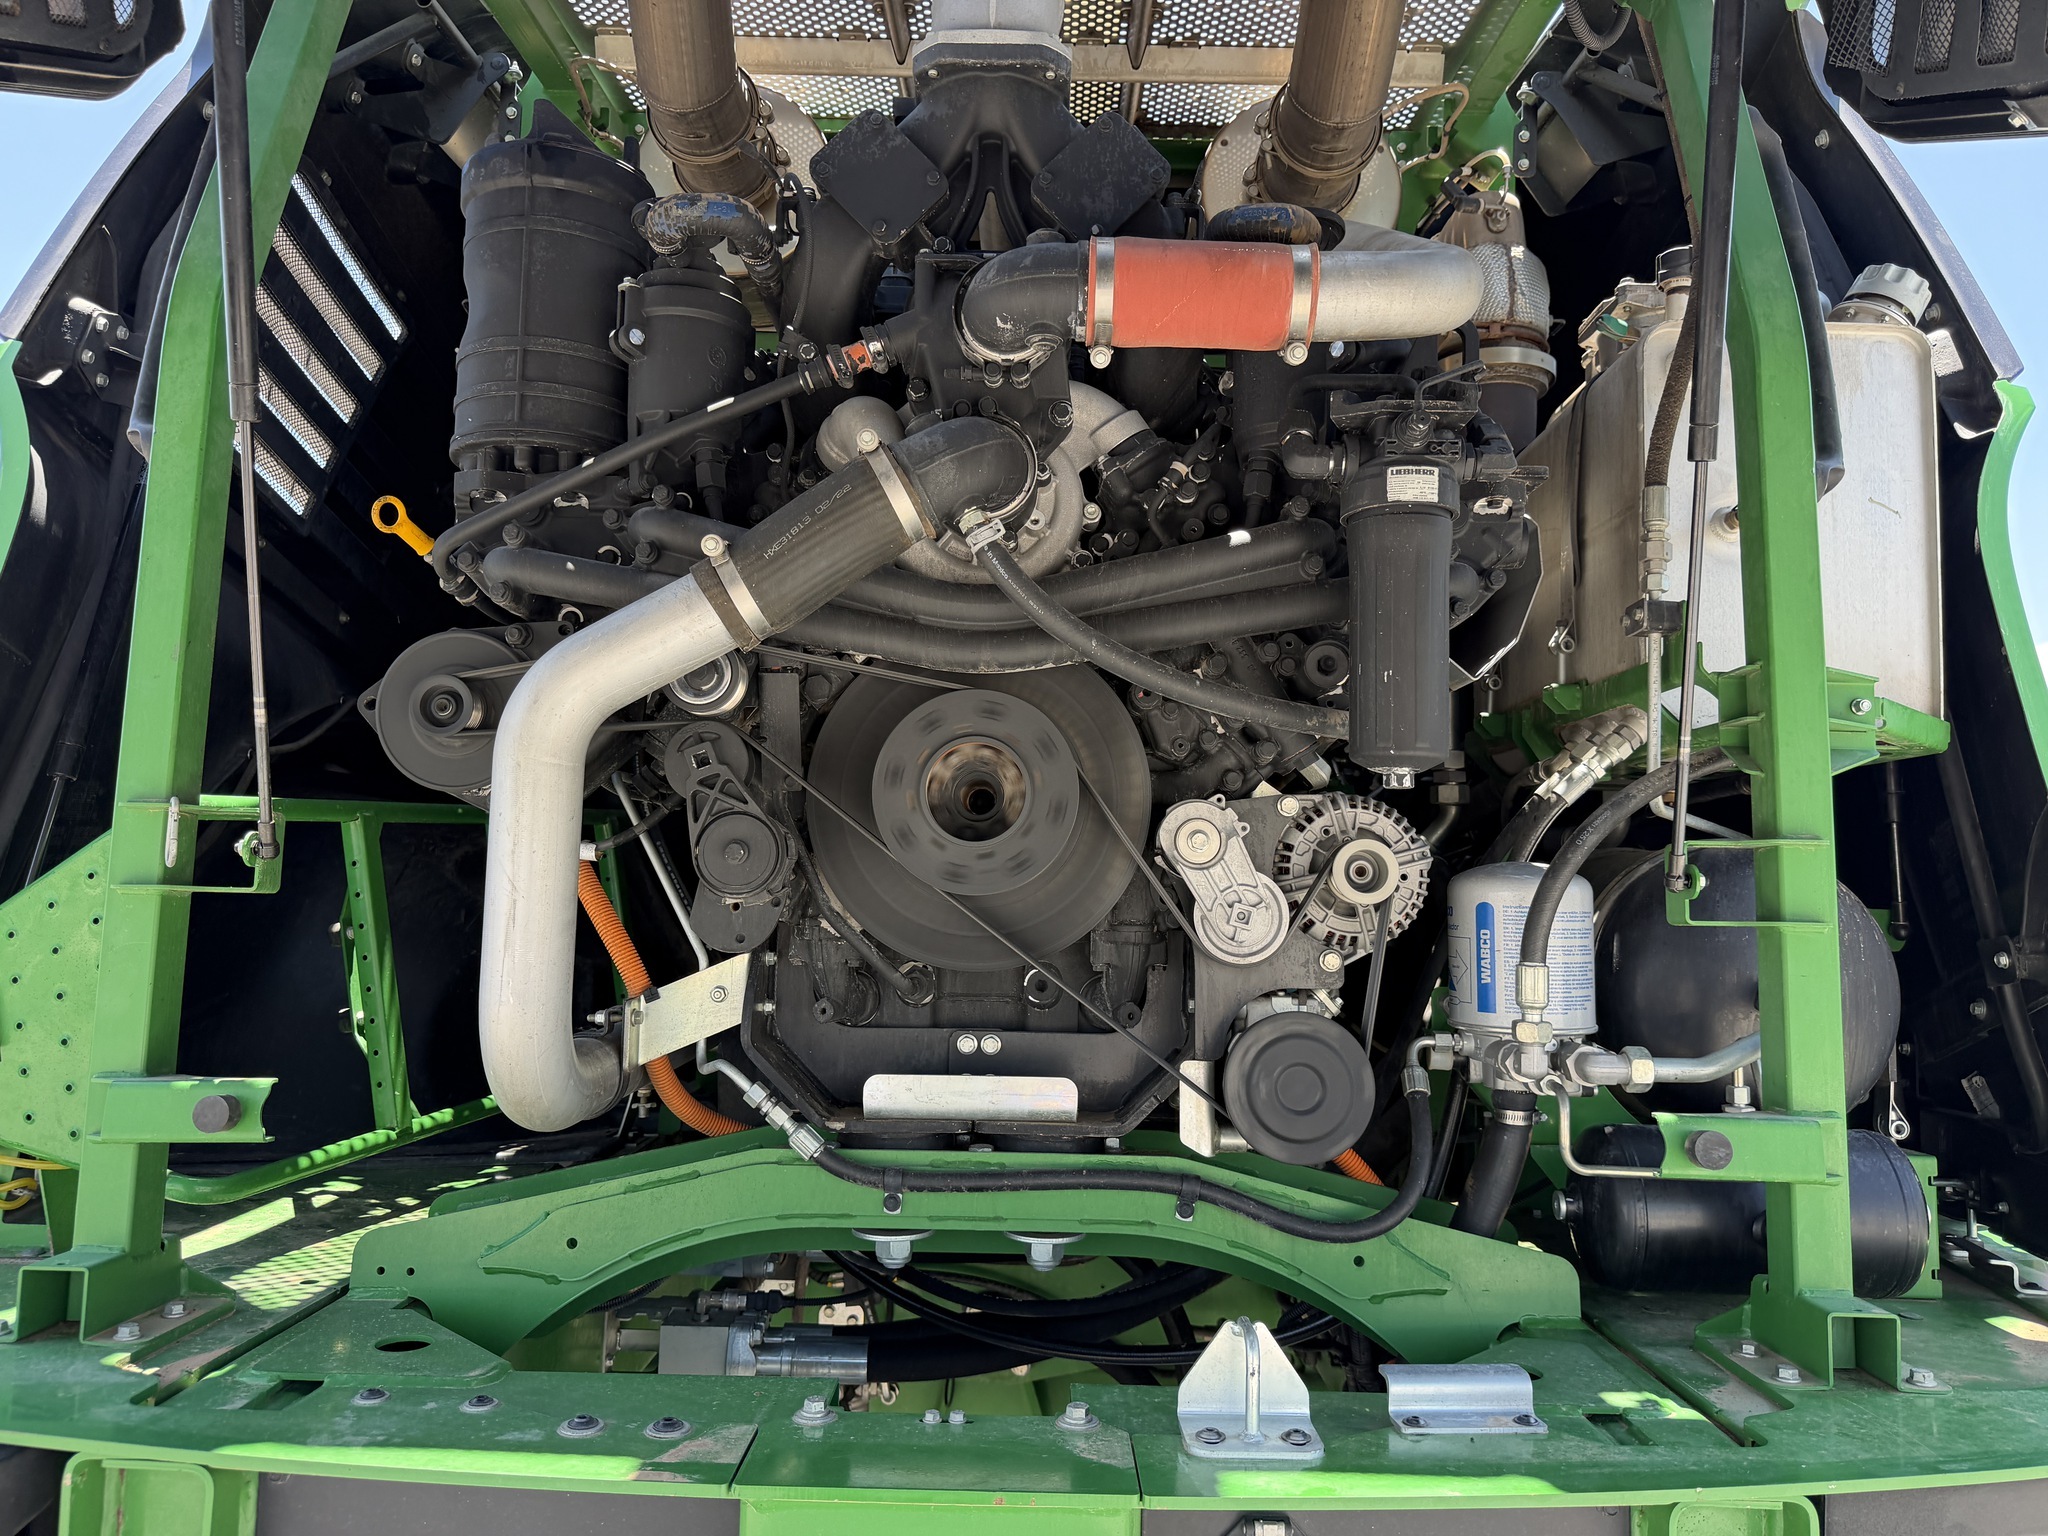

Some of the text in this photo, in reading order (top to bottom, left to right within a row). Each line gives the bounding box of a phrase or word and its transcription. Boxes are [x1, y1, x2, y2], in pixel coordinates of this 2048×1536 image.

[1390, 468, 1436, 476] LIEBHERR
[763, 483, 852, 560] HXE31813 02/22
[1480, 929, 1492, 984] WABCO
